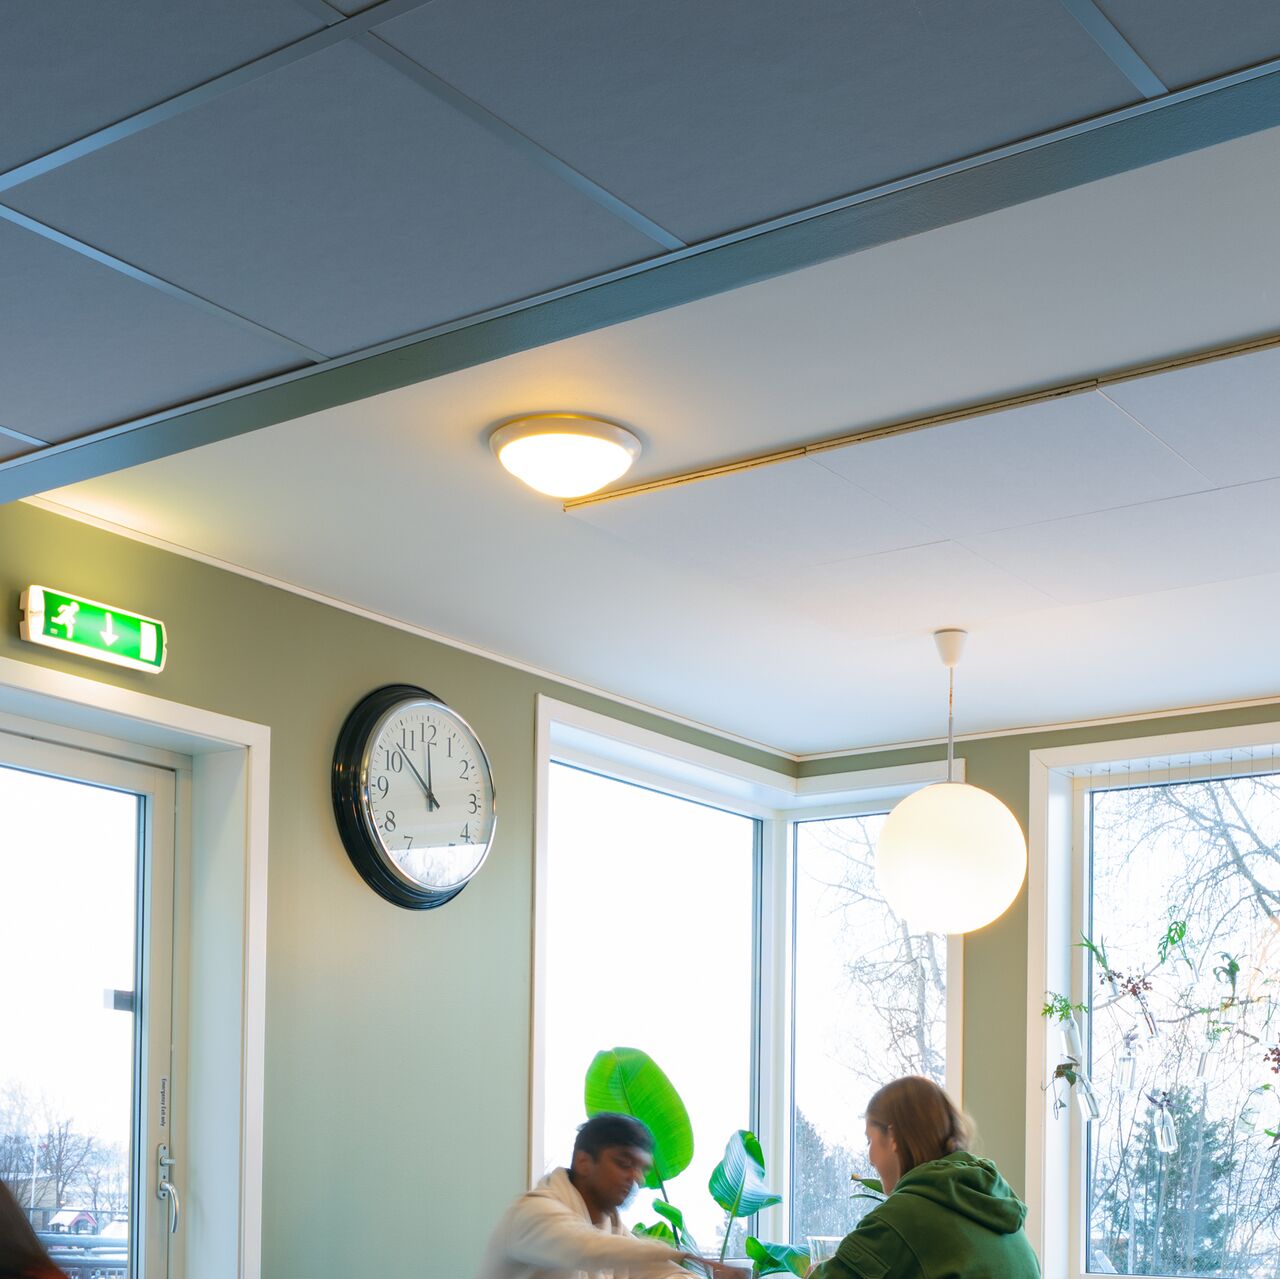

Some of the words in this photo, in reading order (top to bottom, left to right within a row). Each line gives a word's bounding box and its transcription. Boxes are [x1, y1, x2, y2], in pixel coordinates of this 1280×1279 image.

[401, 728, 416, 751] 11
[419, 722, 437, 746] 12
[447, 737, 453, 758] 1
[385, 749, 403, 773] 10
[459, 760, 469, 780] 2
[377, 775, 389, 799] 9
[467, 793, 478, 814] 3
[384, 810, 396, 832] 8
[460, 821, 471, 843] 4
[403, 835, 414, 854] 7
